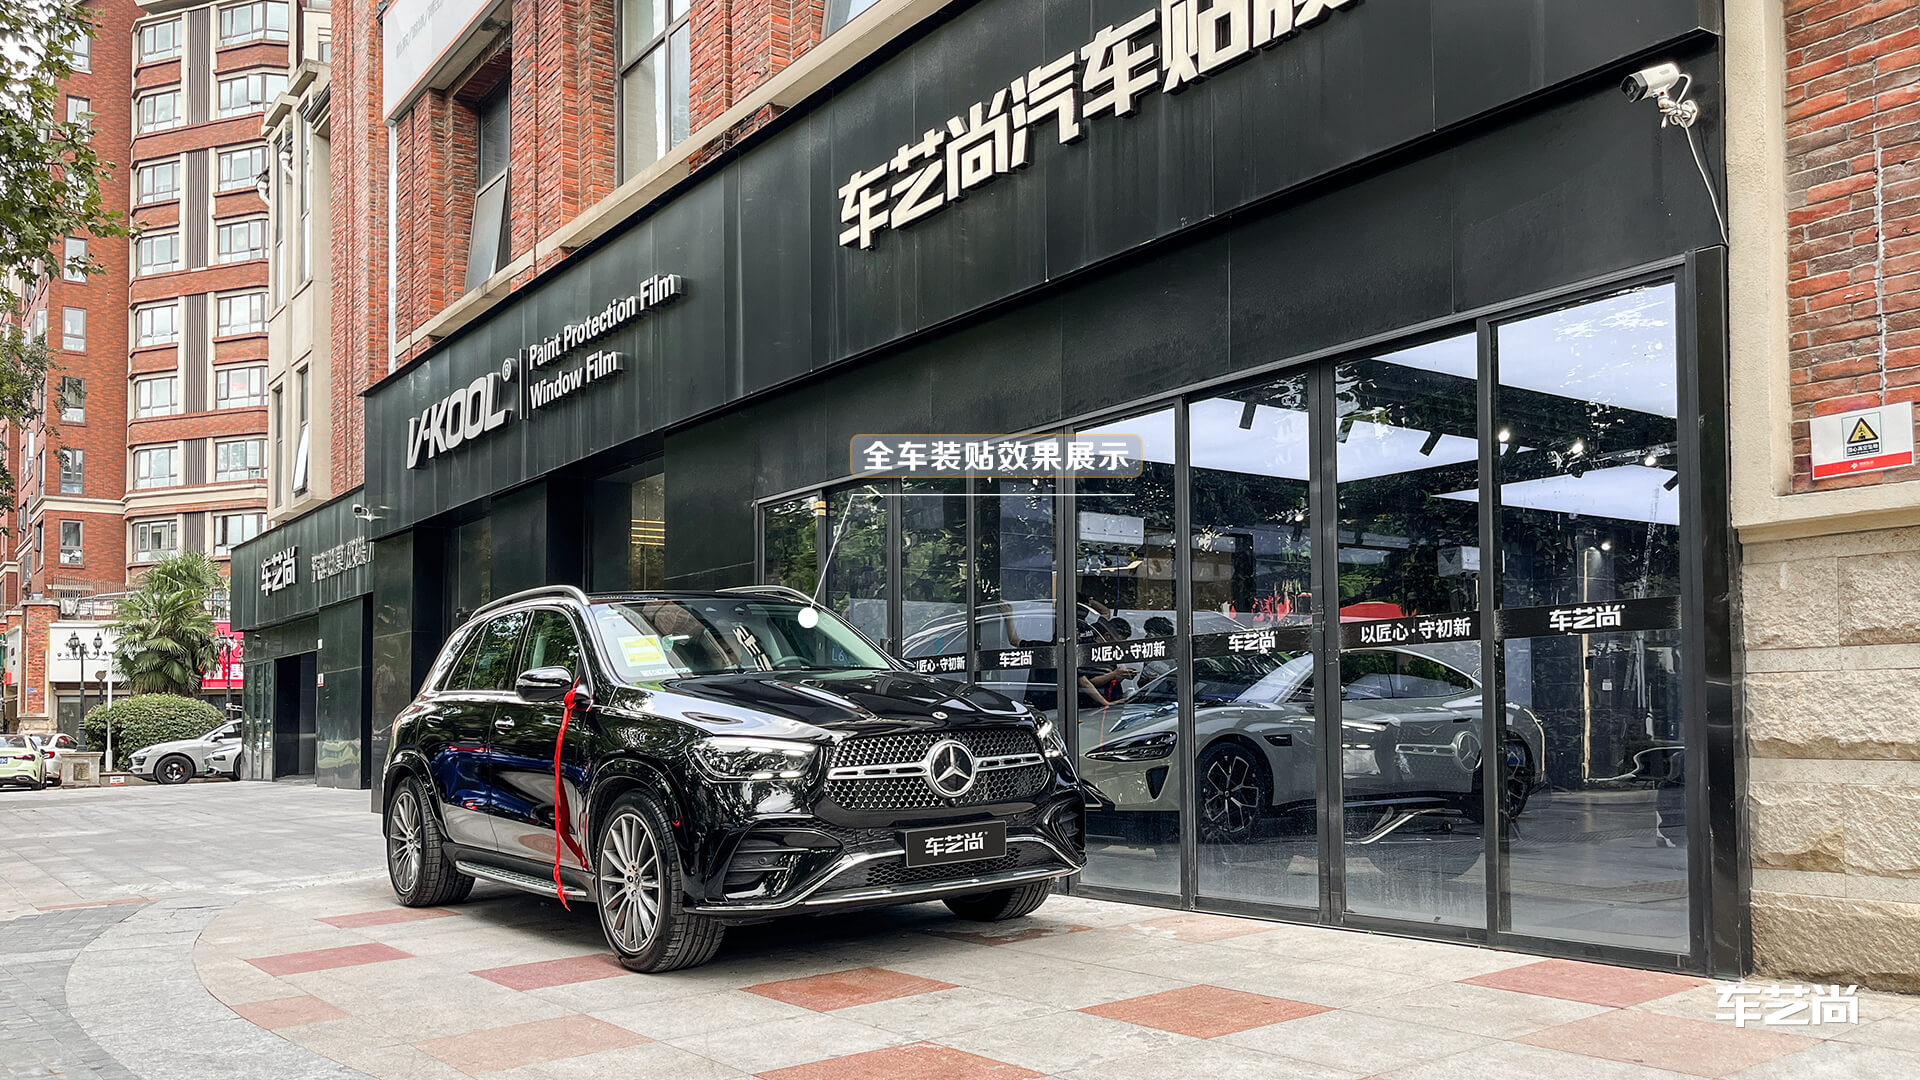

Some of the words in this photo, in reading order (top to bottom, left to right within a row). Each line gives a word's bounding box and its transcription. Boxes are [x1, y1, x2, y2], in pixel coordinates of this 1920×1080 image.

[529, 333, 562, 370] Paint
[563, 295, 637, 351] Protection
[640, 274, 676, 311] Film
[530, 367, 583, 409] Window
[586, 350, 618, 383] Film
[261, 546, 296, 596] 车艺尚
[1360, 616, 1472, 644] 以匠心·守初新
[1549, 605, 1623, 631] 车艺尚
[1091, 640, 1166, 662] 以匠心·守初新
[1228, 631, 1276, 653] 车艺尚
[999, 651, 1033, 668] 车艺尚
[924, 831, 984, 856] 车艺尚
